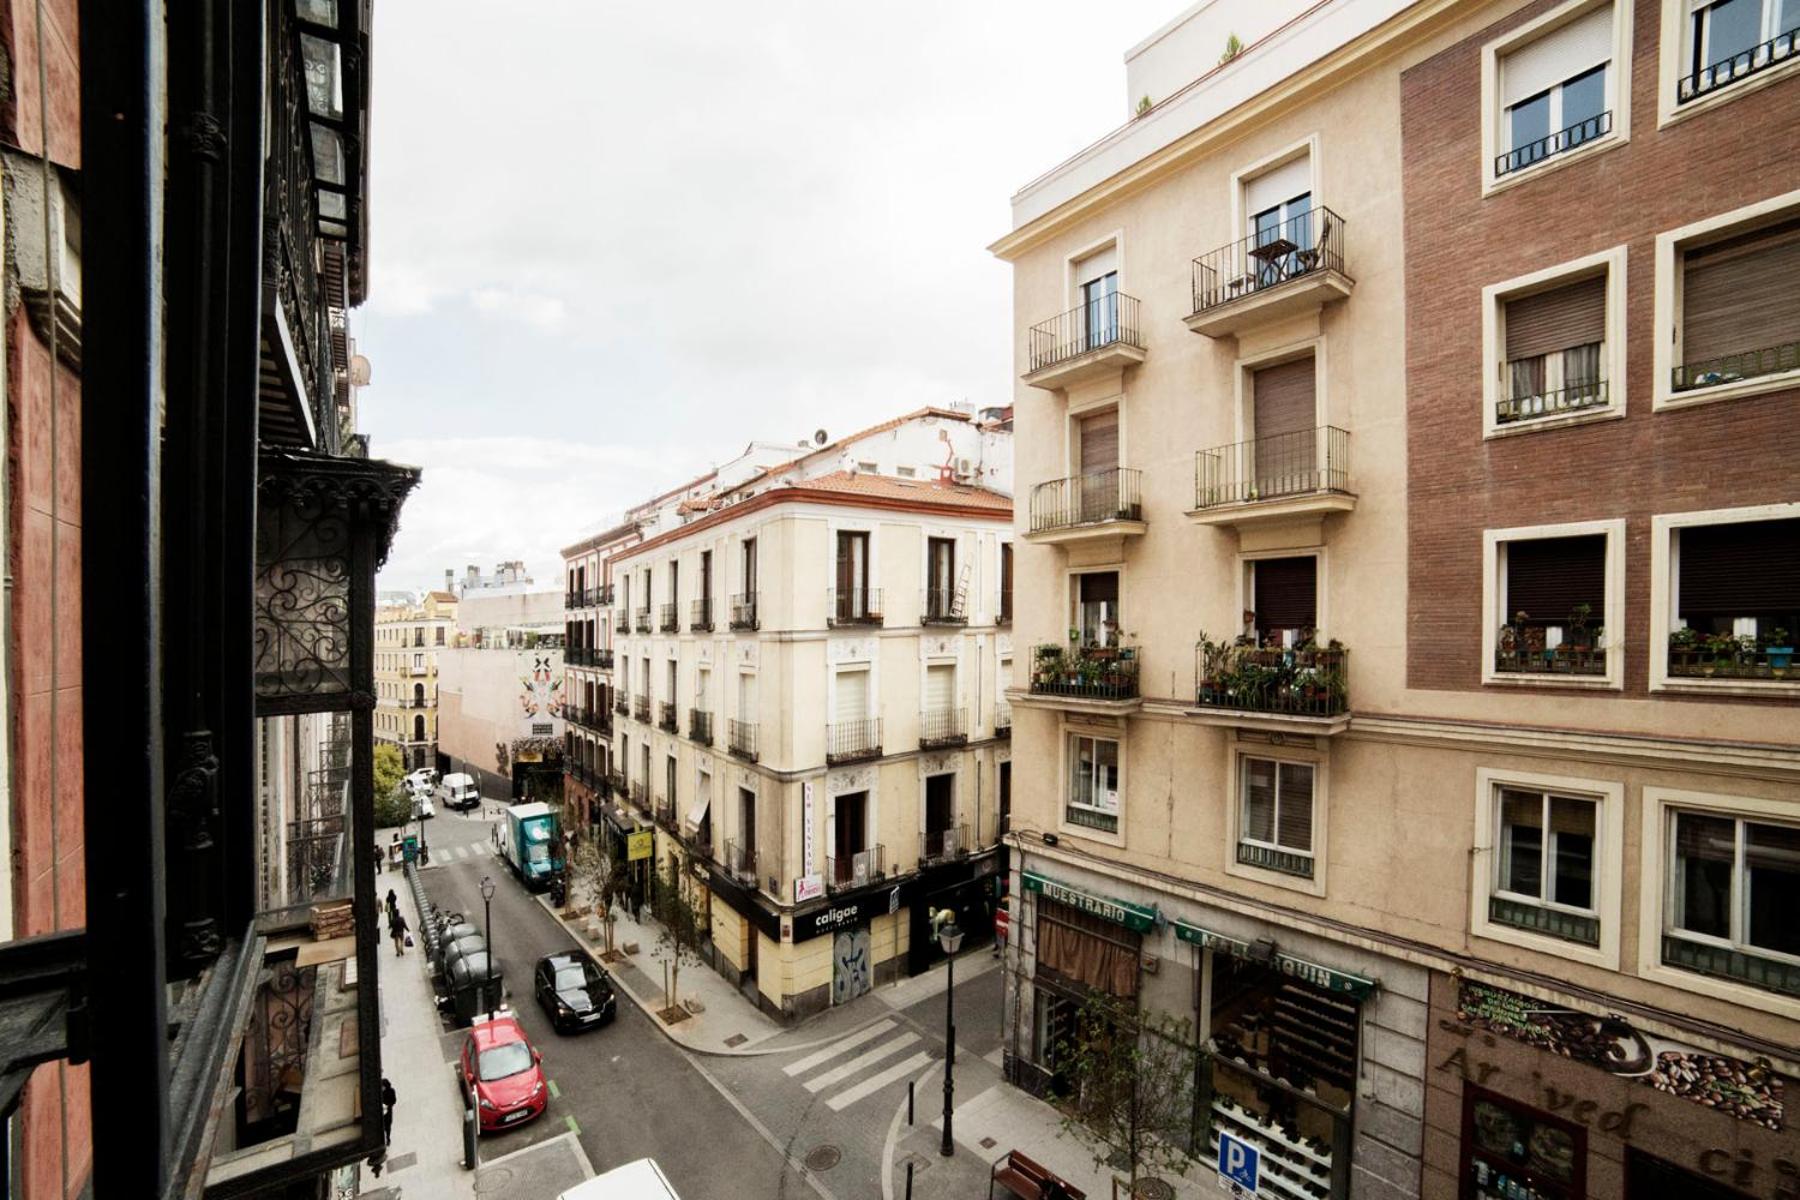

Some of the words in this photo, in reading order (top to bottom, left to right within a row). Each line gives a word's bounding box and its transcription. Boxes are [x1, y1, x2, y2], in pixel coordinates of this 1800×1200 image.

[815, 905, 858, 926] caligae
[1042, 882, 1125, 922] MUESTRARIO
[1201, 932, 1331, 988] MLLRQUIN
[1227, 1140, 1246, 1174] P
